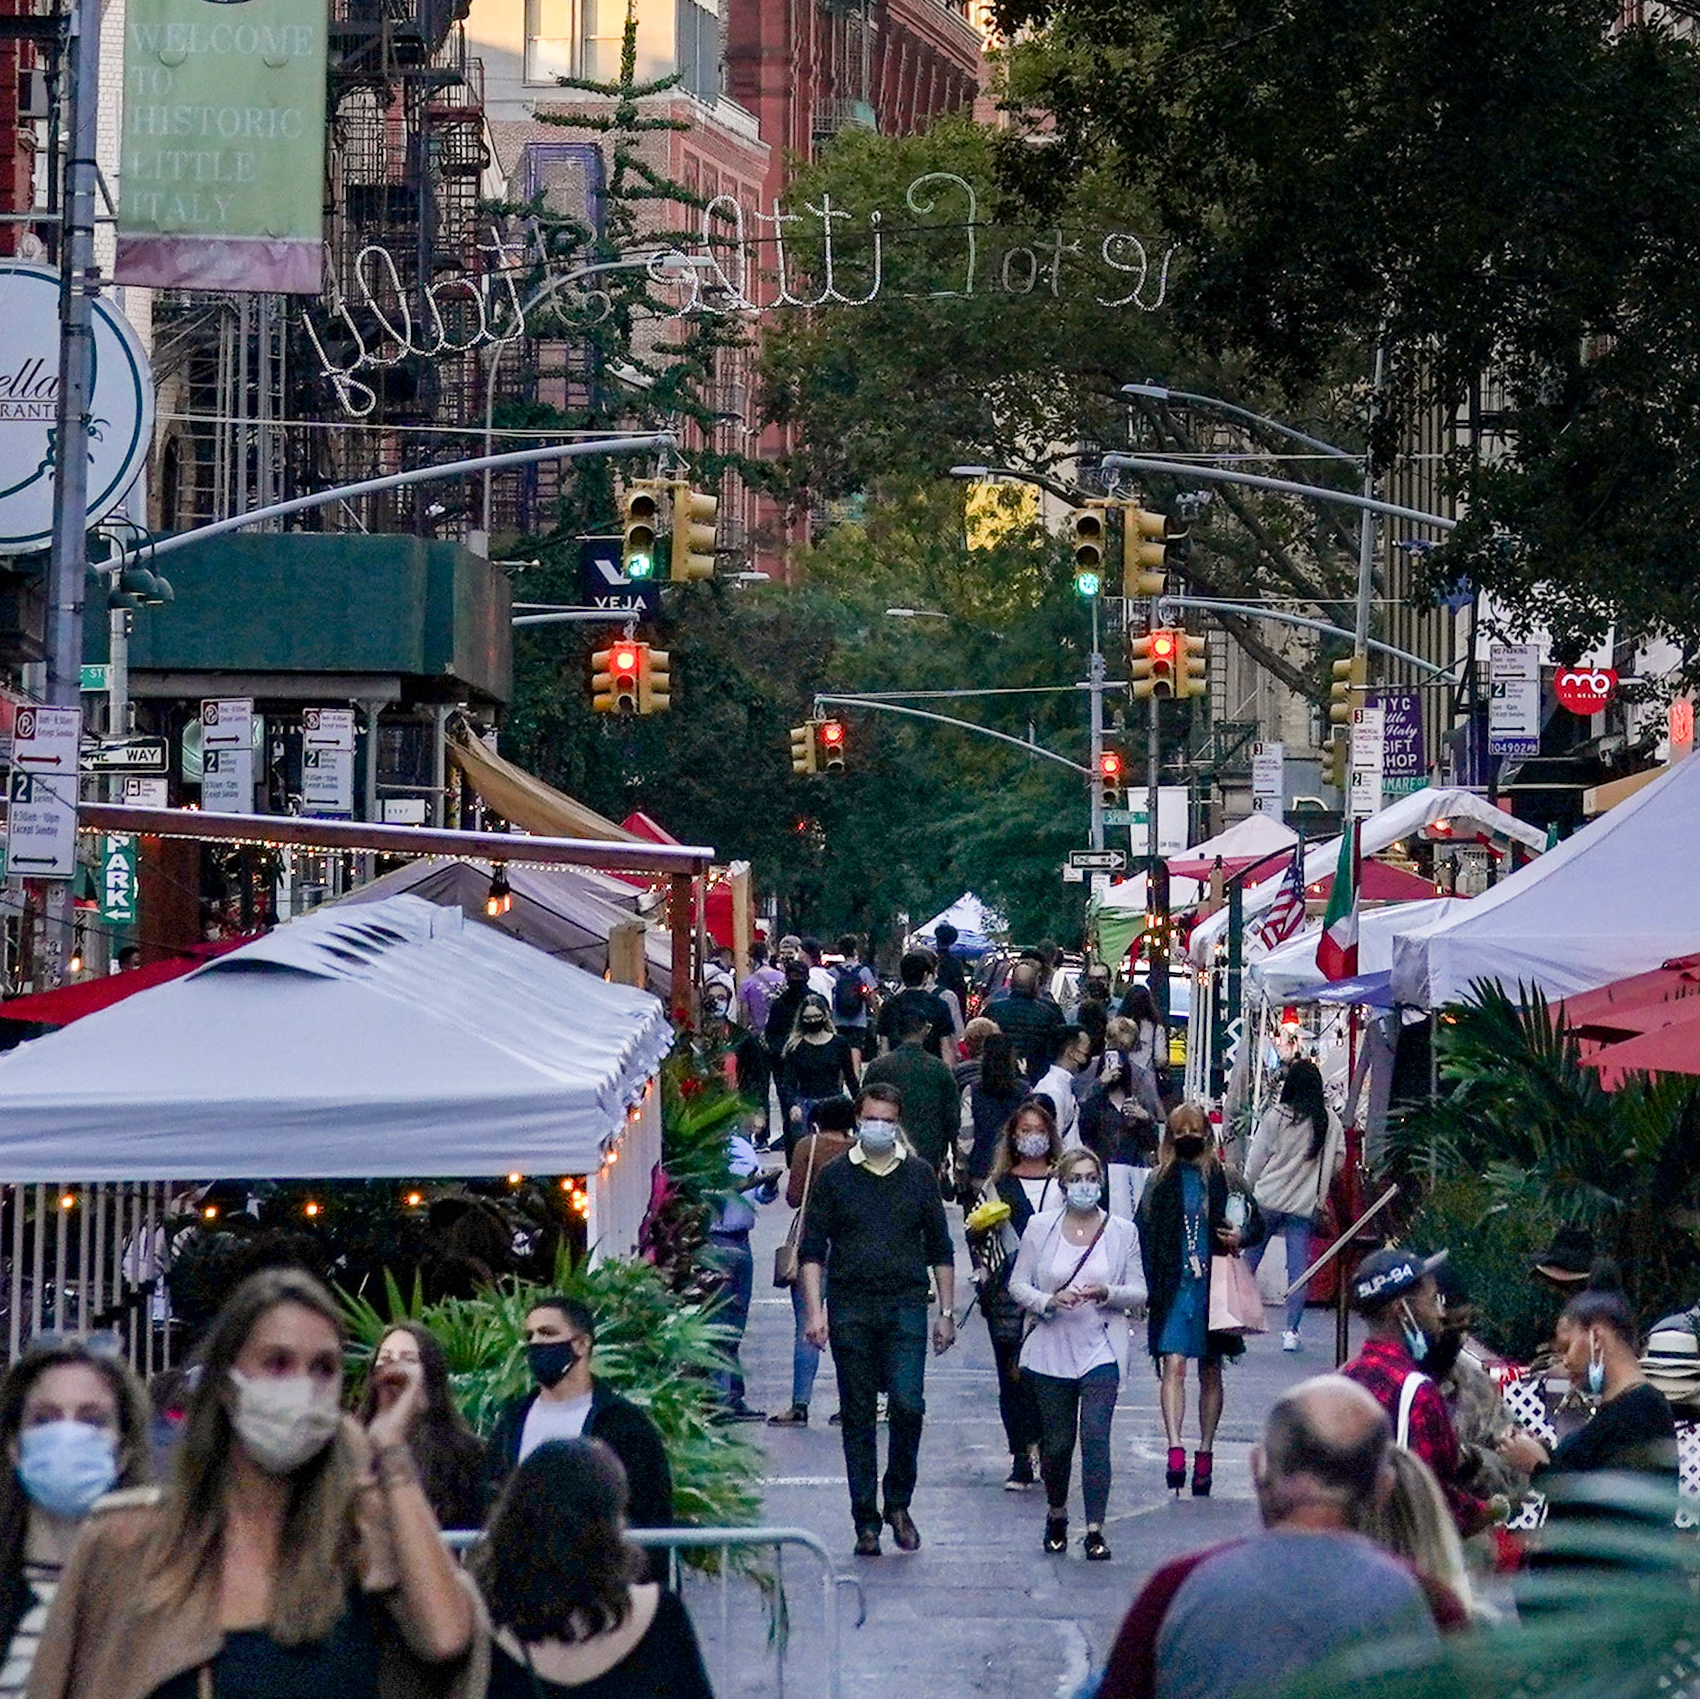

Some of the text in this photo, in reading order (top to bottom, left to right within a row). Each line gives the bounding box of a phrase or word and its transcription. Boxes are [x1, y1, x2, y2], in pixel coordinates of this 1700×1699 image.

[129, 22, 314, 55] WELCOME
[129, 66, 173, 95] TO
[131, 106, 303, 139] HISTORIC
[131, 151, 257, 183] LITTLE
[131, 191, 234, 225] ITALY
[594, 595, 646, 610] VEJA
[1378, 697, 1411, 711] NYC
[1384, 712, 1407, 724] ttle
[126, 749, 158, 762] WAY
[1383, 740, 1413, 754] GIFT
[207, 752, 216, 771] 2
[308, 751, 316, 767] 2
[15, 774, 28, 801] 2
[1383, 776, 1415, 792] NMARE
[1075, 855, 1118, 865] ONE WAY
[106, 837, 130, 907] PARK
